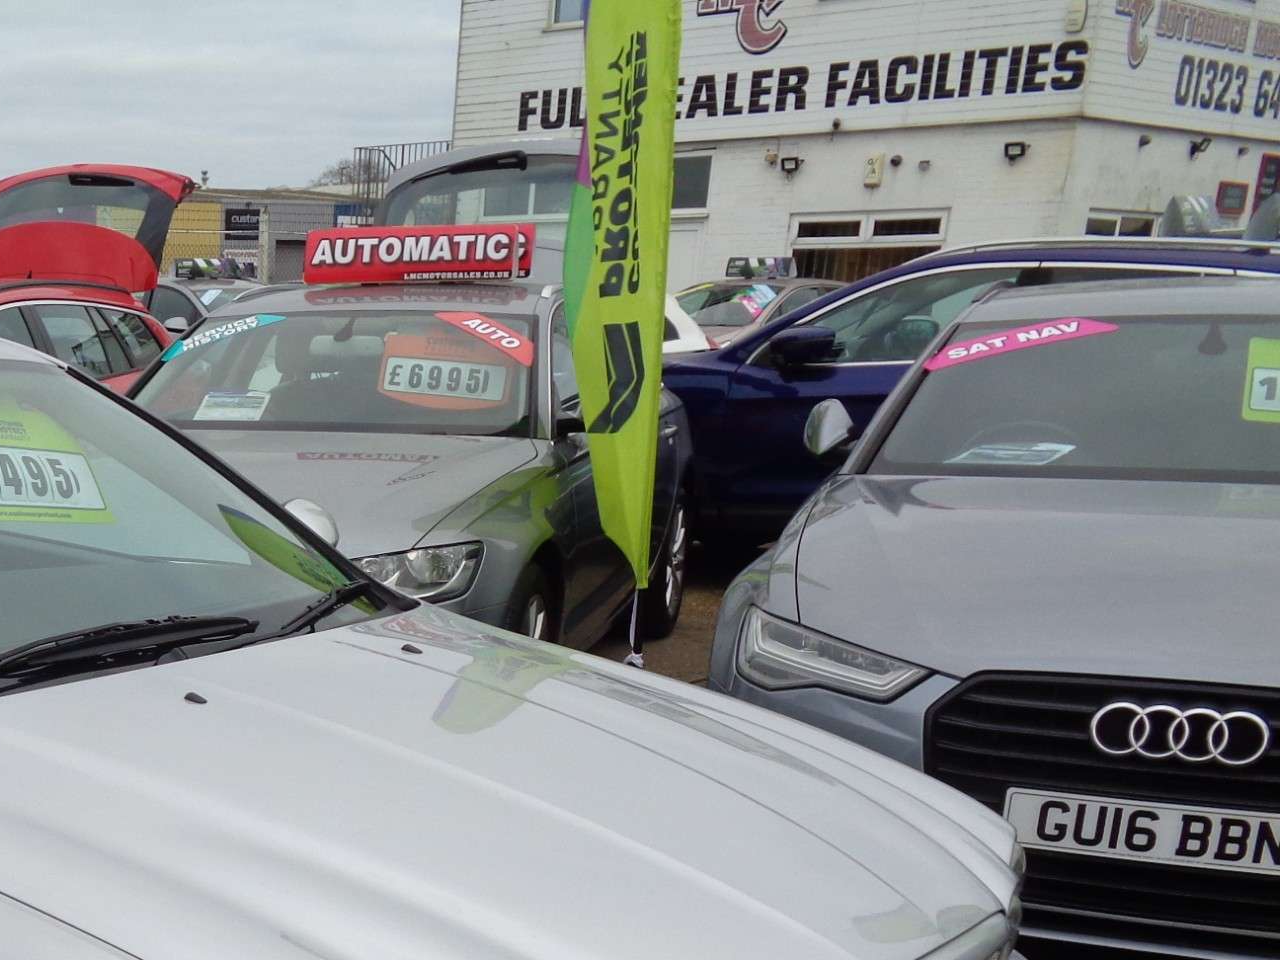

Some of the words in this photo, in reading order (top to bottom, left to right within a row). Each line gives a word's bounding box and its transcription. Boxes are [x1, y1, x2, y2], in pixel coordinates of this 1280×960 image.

[518, 87, 586, 131] FUL
[676, 66, 810, 119] ALER
[825, 40, 1089, 108] FACILITIES
[1174, 55, 1249, 114] 01323
[311, 233, 511, 265] AUTOMATIC
[462, 318, 521, 349] AUTO
[948, 336, 1008, 359] SAT
[1017, 321, 1079, 343] NAV
[1036, 800, 1160, 853] GU16
[1175, 814, 1280, 866] BBN
